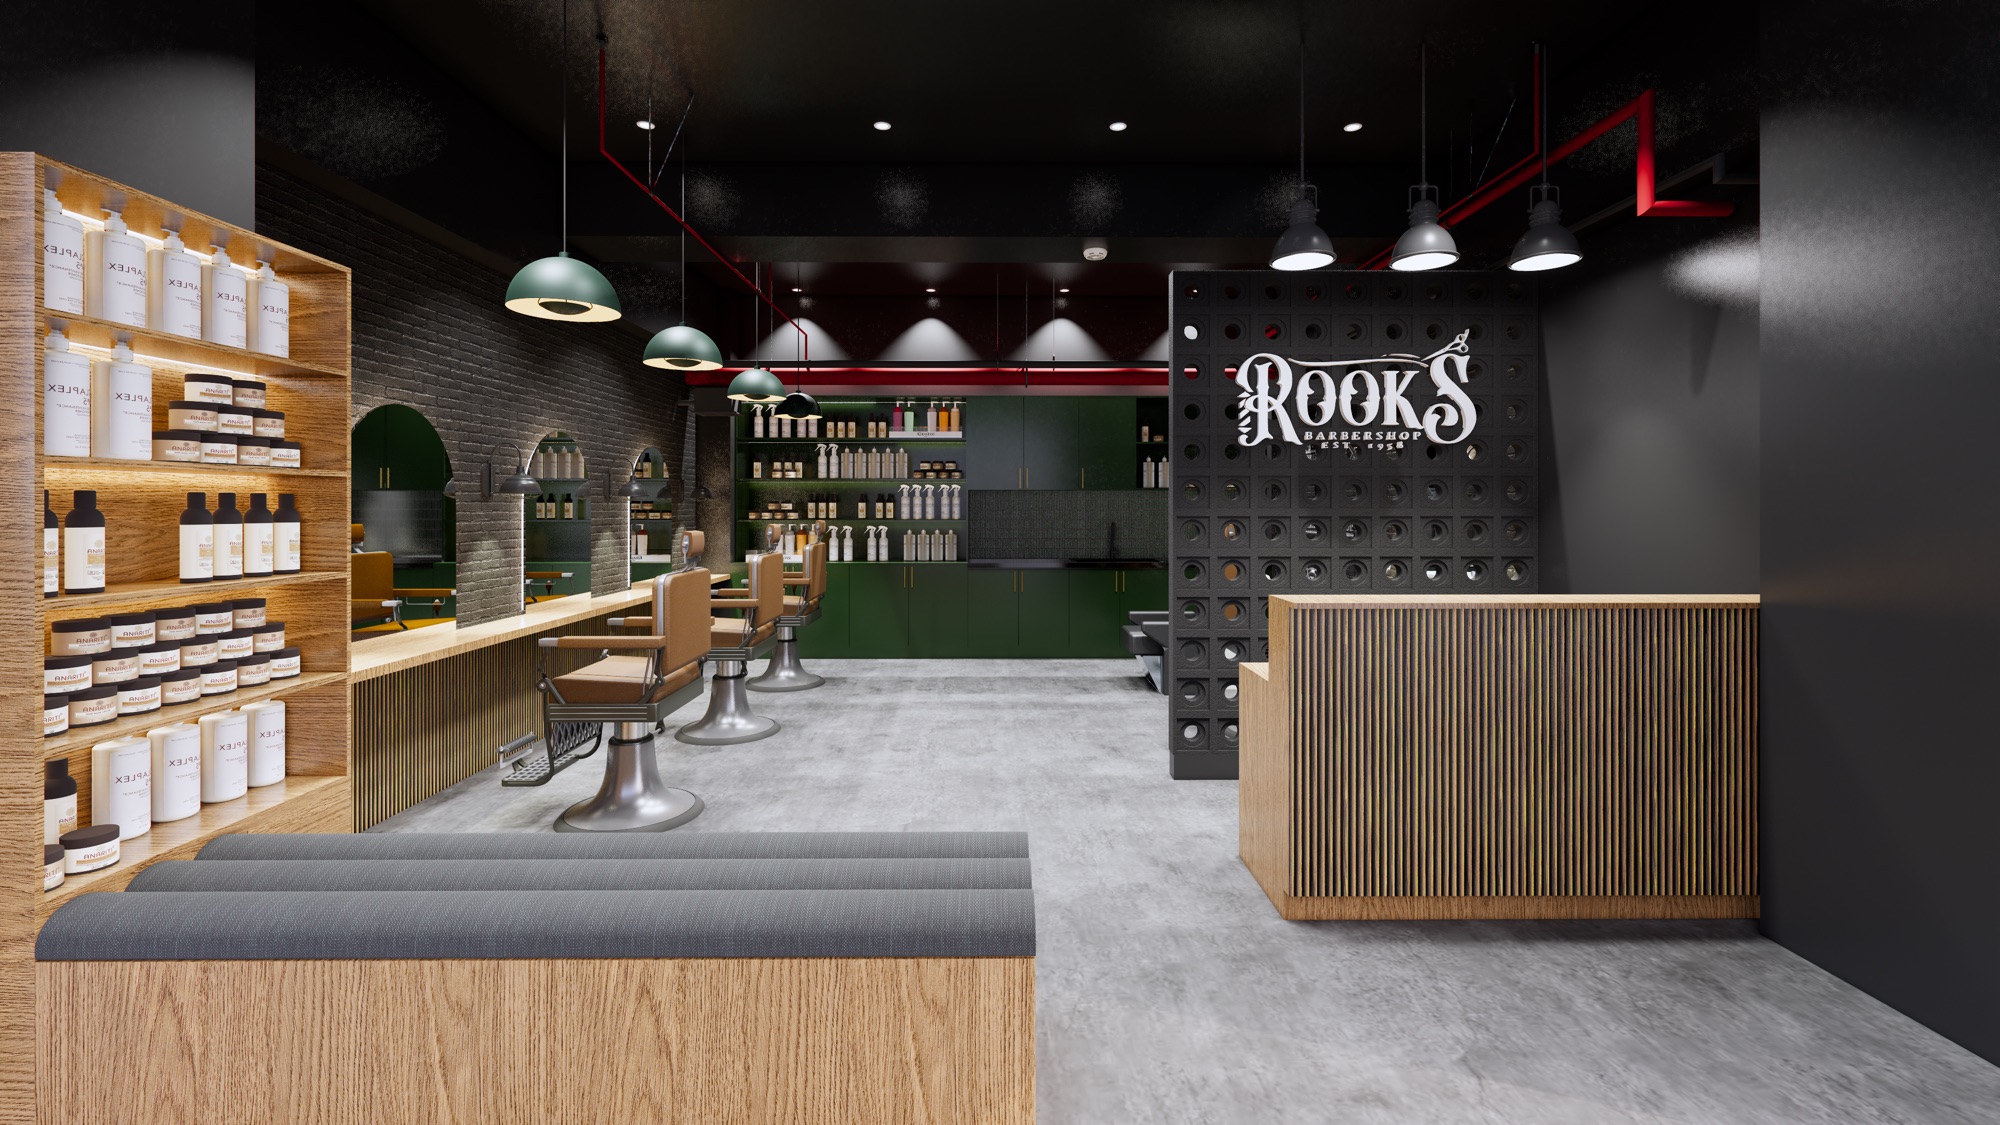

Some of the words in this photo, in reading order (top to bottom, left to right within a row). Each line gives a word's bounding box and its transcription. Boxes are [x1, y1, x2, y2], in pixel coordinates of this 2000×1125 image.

[1235, 353, 1477, 446] ROOKS
[1303, 431, 1422, 441] BARBERSHOP
[1367, 441, 1404, 451] 1958
[83, 847, 113, 860] ANARITI
